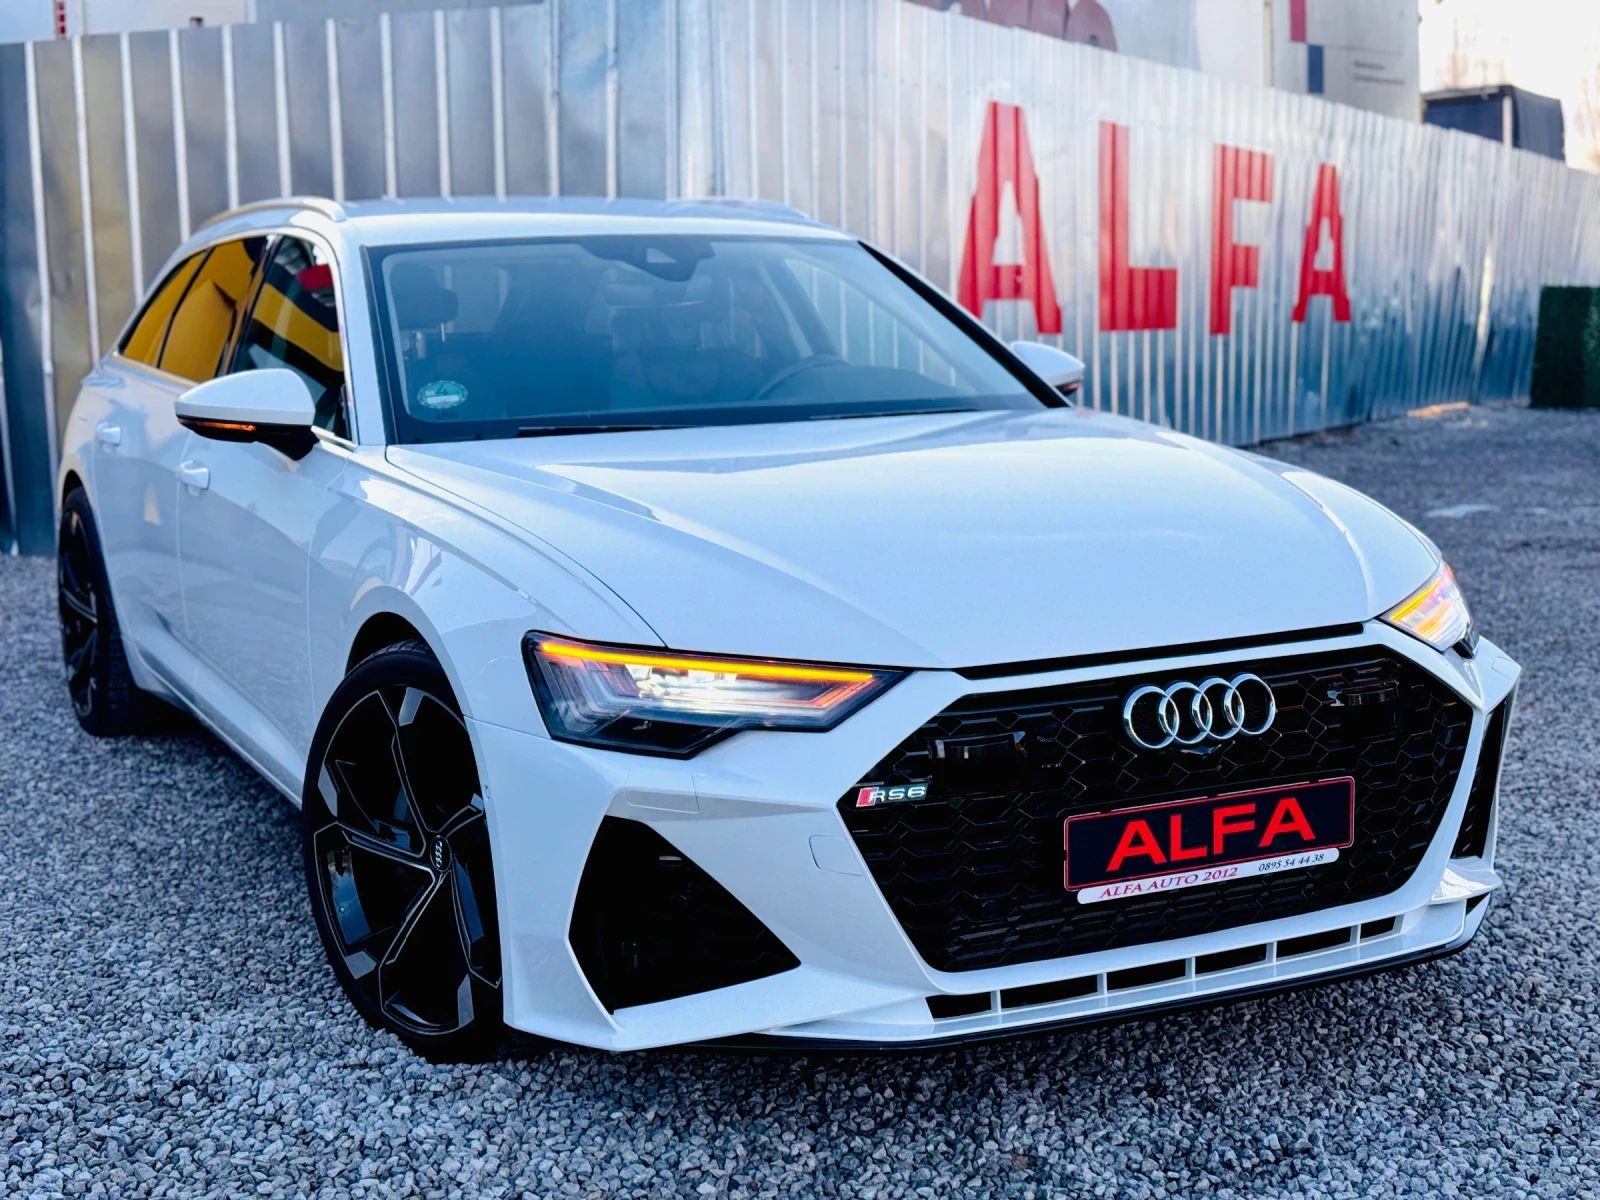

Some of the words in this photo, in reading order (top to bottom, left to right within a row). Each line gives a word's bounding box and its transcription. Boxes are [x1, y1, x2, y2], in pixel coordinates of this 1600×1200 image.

[957, 101, 1351, 334] ALFA
[867, 786, 926, 803] RS6
[1106, 797, 1316, 872] ALFA
[1258, 860, 1282, 872] 0895
[1283, 858, 1296, 867] 54
[1298, 855, 1310, 865] 44
[1312, 853, 1325, 862] 38
[1099, 883, 1142, 899] ALFA
[1146, 873, 1199, 891] AUTO
[1202, 867, 1238, 881] 2012
